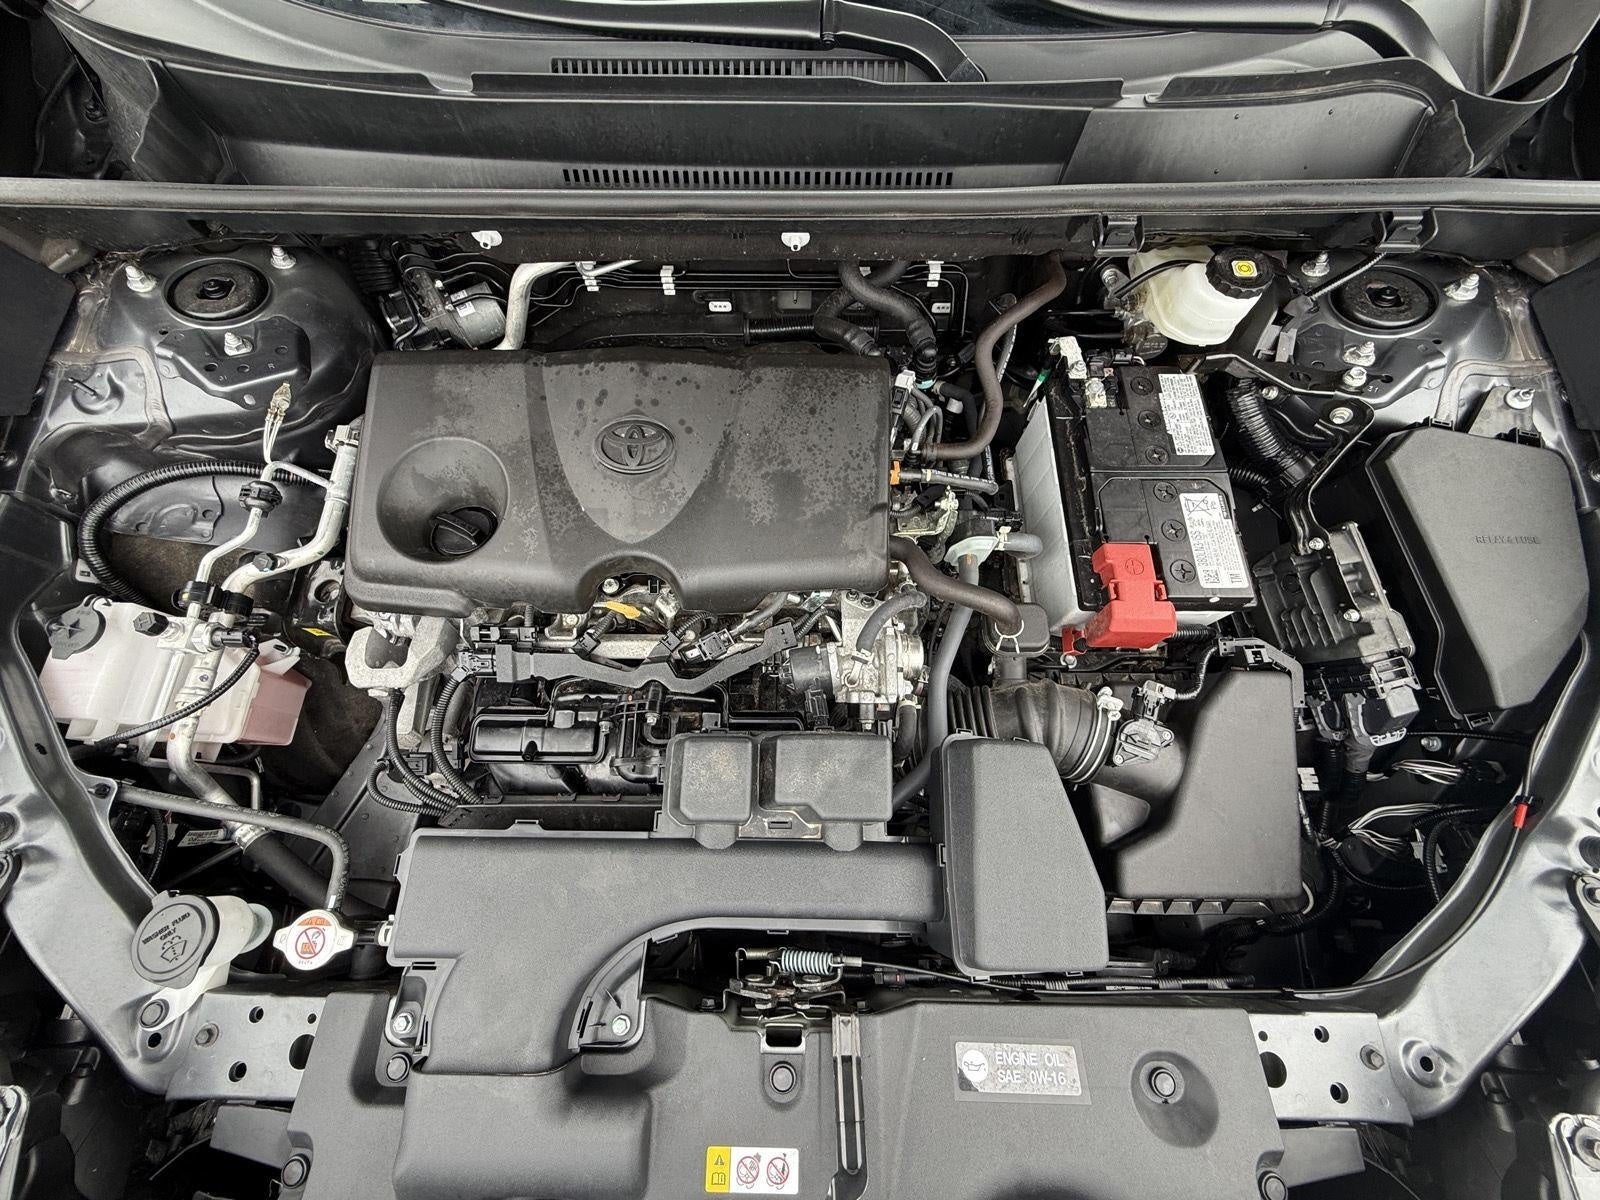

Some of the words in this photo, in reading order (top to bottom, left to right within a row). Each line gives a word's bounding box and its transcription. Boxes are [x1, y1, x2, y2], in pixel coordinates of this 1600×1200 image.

[171, 912, 191, 927] FLUID
[159, 927, 177, 941] ONLY
[995, 1051, 1038, 1066] ENGINE
[1044, 1053, 1065, 1067] OIL
[997, 1070, 1021, 1083] SAE
[1029, 1071, 1067, 1086] 0W-16
